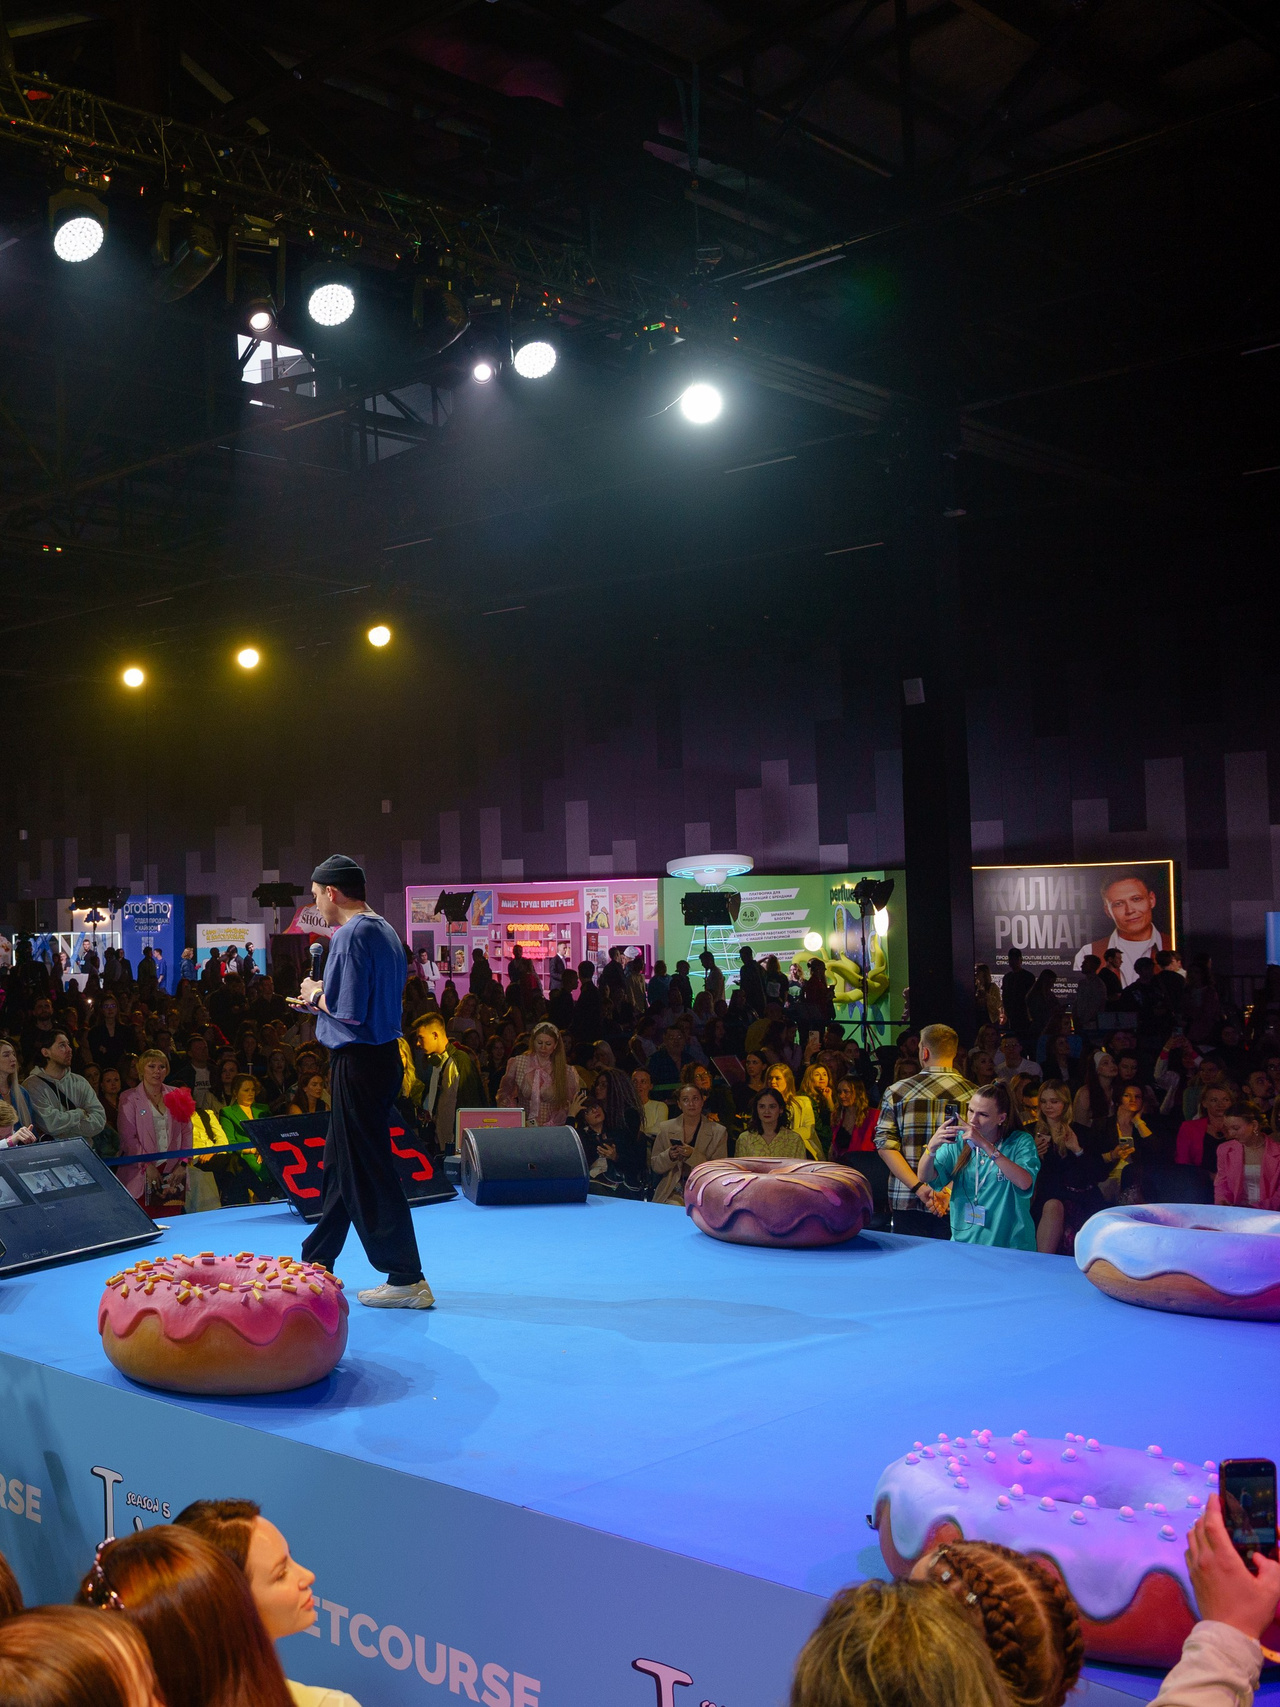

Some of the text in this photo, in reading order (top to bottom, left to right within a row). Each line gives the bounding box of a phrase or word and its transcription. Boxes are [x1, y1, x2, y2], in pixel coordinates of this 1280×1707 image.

[501, 898, 575, 909] МИР! ТРУД! ПРОГРЕВ!
[990, 876, 1087, 912] КИЛИН
[994, 914, 1093, 949] РОМАН
[302, 1594, 541, 1707] ETCOURSE
